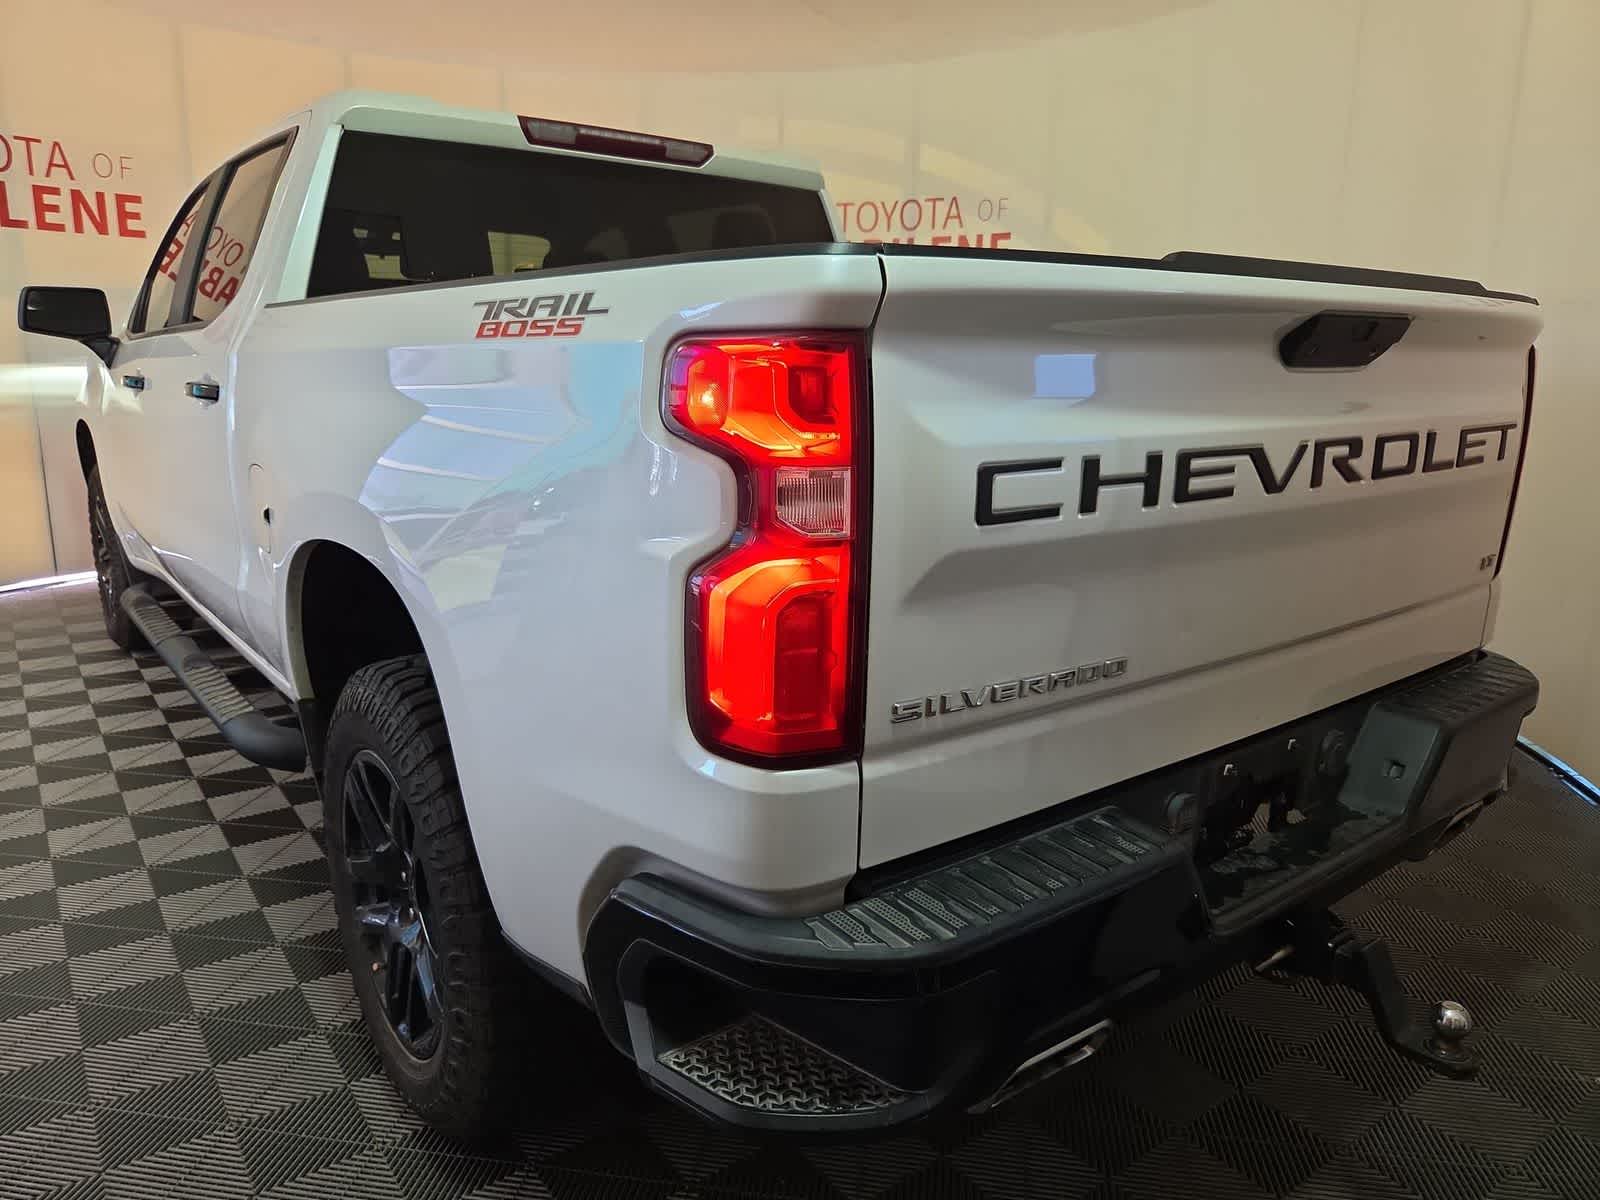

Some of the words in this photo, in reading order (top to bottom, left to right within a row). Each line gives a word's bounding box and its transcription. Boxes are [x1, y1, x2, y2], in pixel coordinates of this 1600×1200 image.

[92, 152, 134, 180] OF
[836, 196, 963, 233] TOYOTA
[977, 197, 1009, 222] OF
[473, 291, 609, 321] TRAIL
[475, 316, 585, 338] BOSS
[974, 422, 1518, 527] CHEVROLET
[891, 656, 1128, 724] SILVERADO
